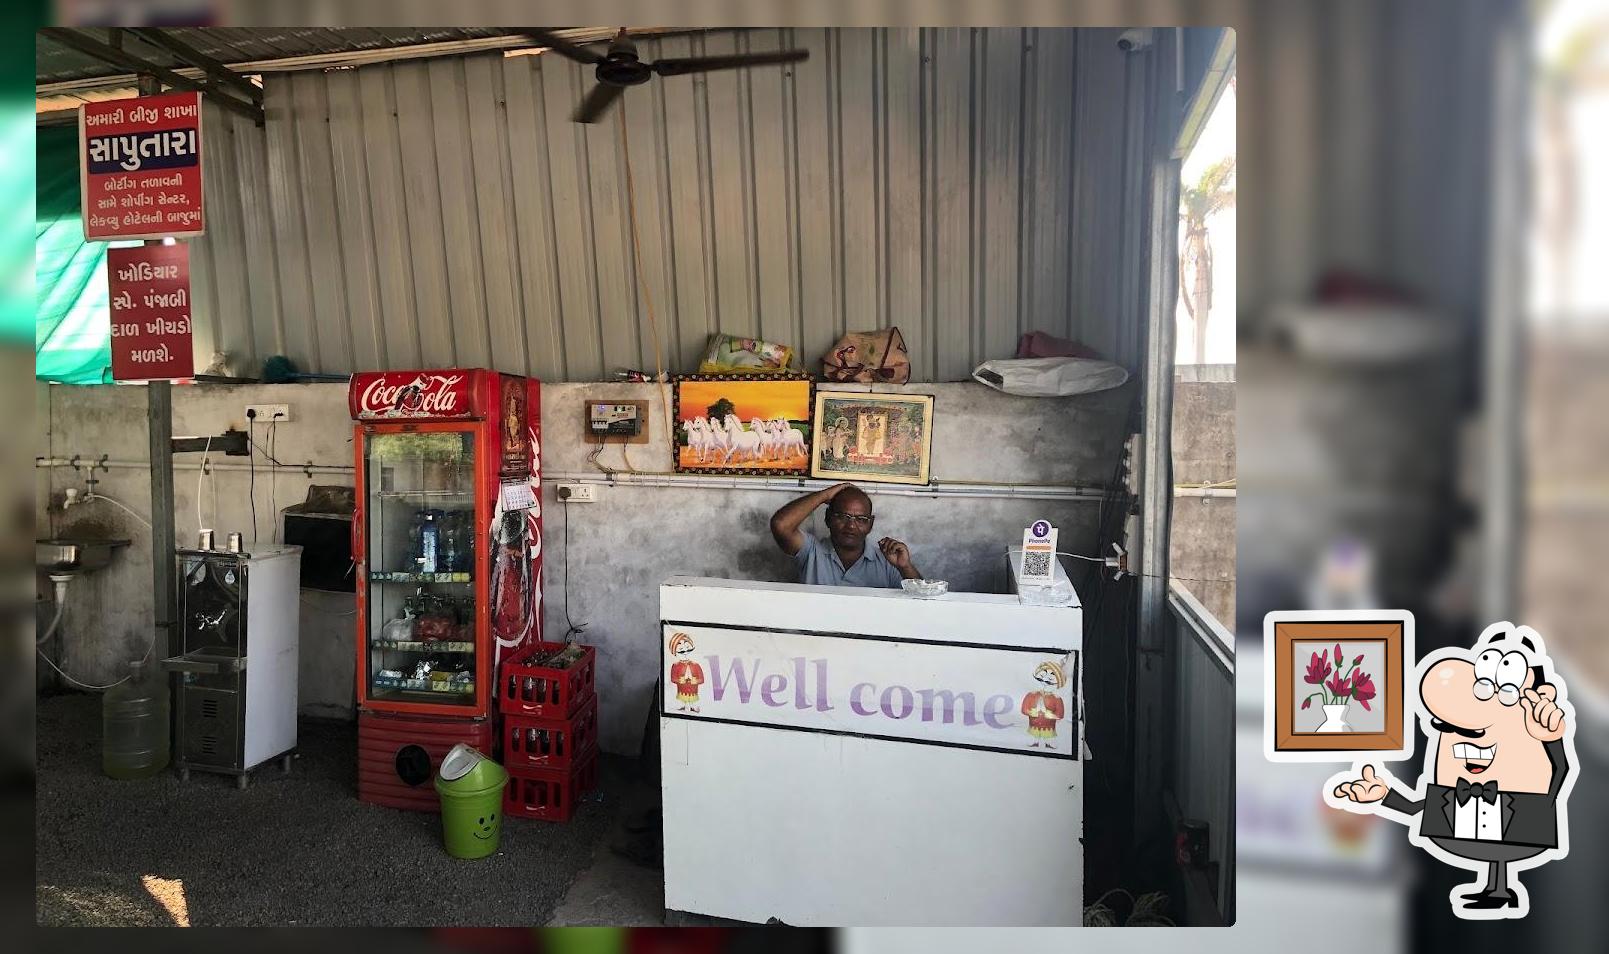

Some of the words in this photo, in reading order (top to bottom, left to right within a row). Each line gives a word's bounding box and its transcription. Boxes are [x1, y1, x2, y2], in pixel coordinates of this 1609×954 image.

[86, 108, 124, 126] અમારી
[129, 105, 159, 124] બીજી
[164, 104, 197, 120] શાખા
[89, 130, 196, 171] સાપુતારા
[140, 173, 183, 188] તળાવની
[98, 195, 117, 209] સામે
[123, 210, 163, 226] હોટેલની
[118, 262, 178, 282] ખોડિયાર
[143, 288, 187, 309] પંજાબી
[111, 323, 140, 338] દાળ
[131, 343, 174, 363] મળશે.
[360, 375, 464, 413] Cocaola
[704, 654, 835, 712] Well
[849, 681, 1016, 730] come
